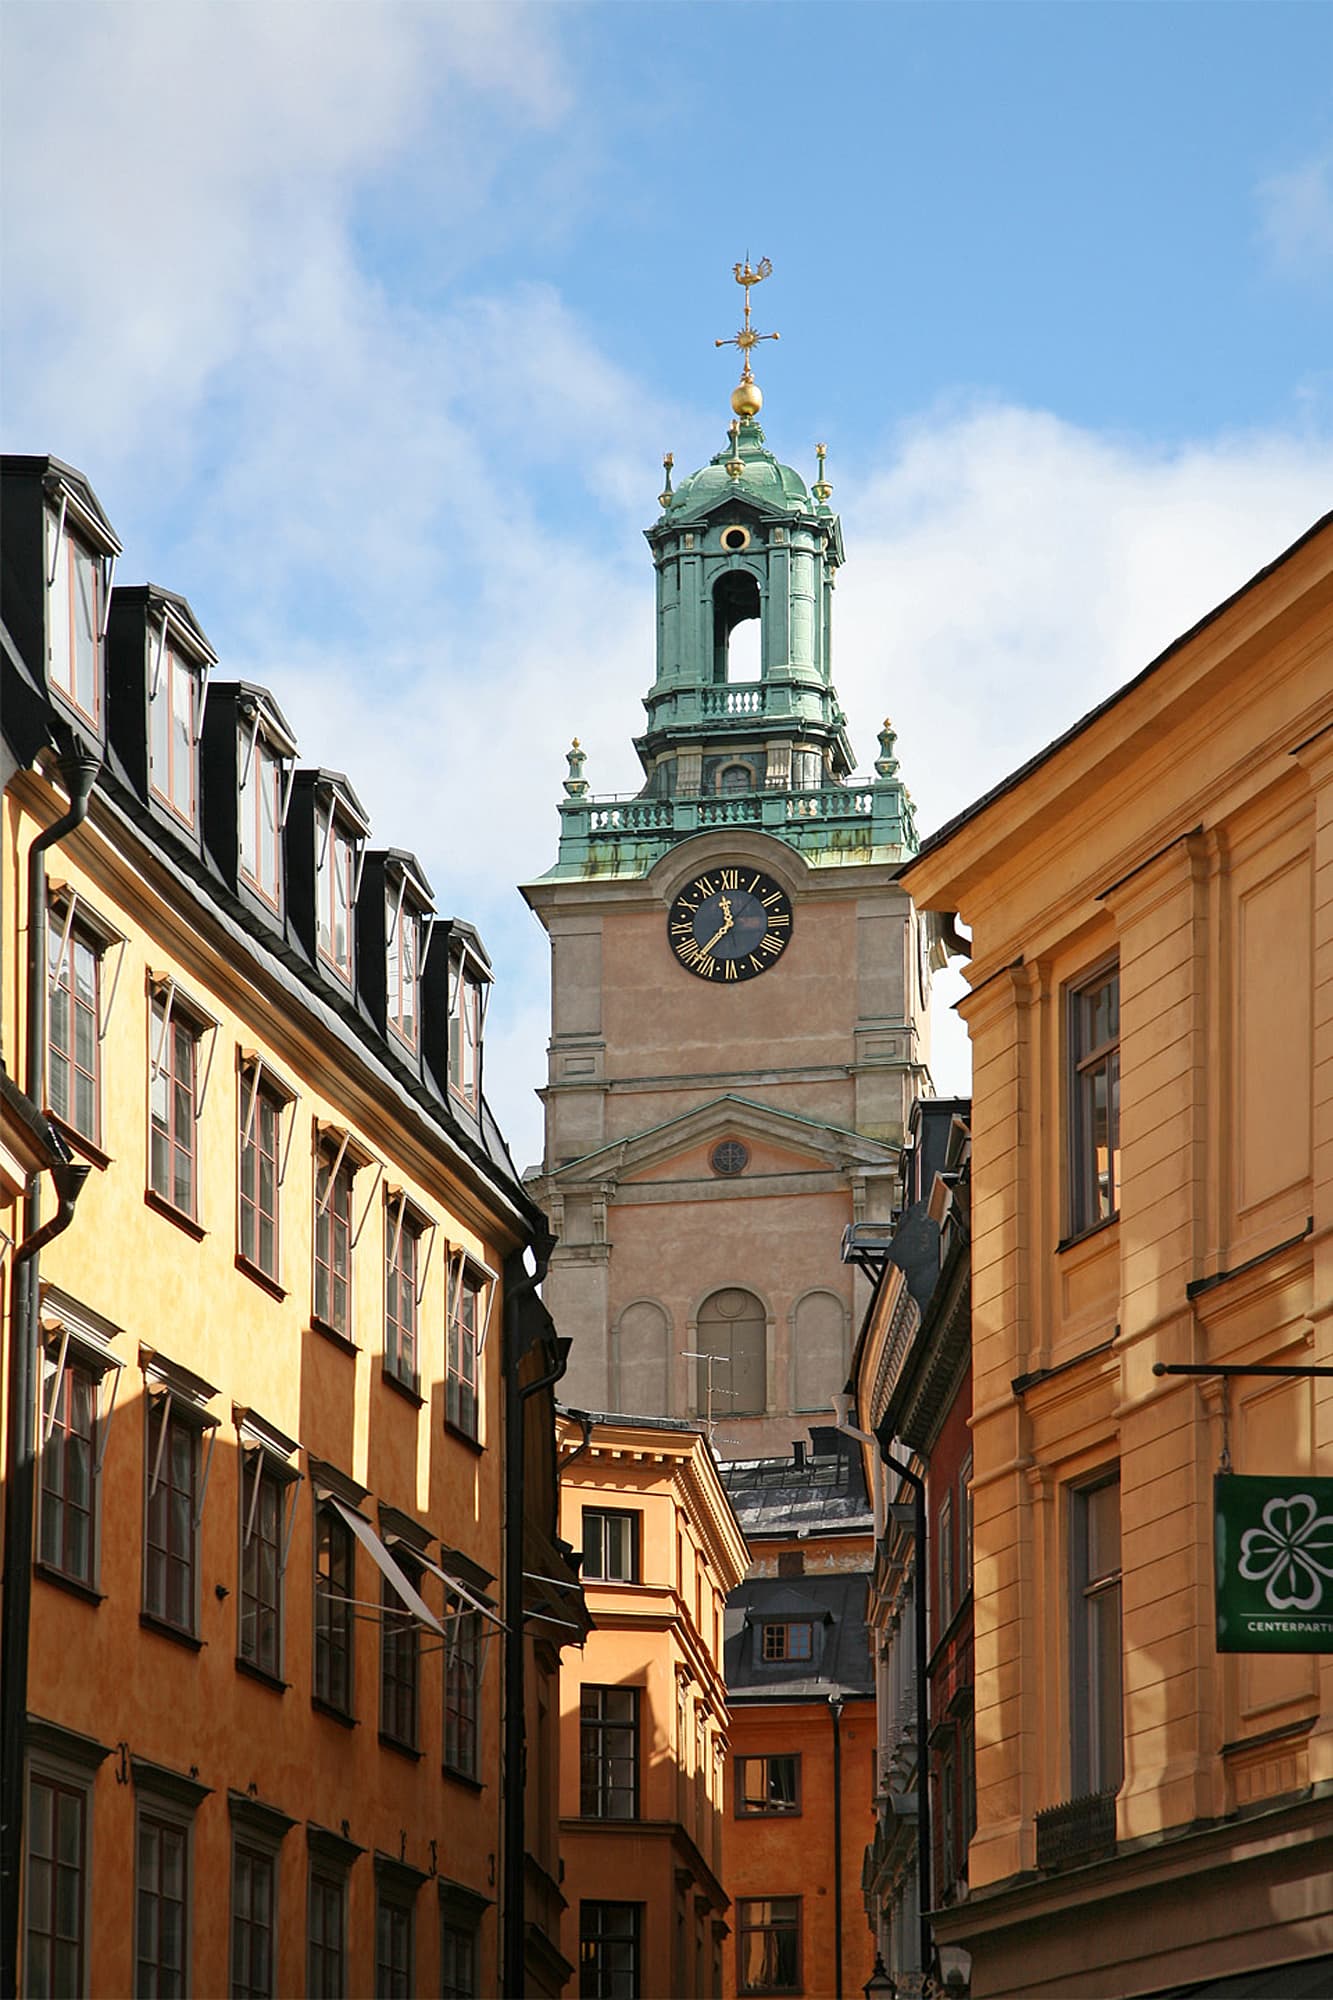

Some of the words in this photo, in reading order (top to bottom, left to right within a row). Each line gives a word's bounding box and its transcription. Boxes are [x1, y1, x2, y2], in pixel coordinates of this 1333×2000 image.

[695, 877, 715, 898] XI
[720, 870, 738, 890] XII
[748, 875, 760, 893] I
[677, 897, 699, 913] X
[761, 891, 783, 907] II
[671, 921, 693, 934] IX
[768, 914, 789, 927] III
[760, 934, 784, 954] IIII
[725, 960, 738, 979] VI
[750, 954, 764, 970] V
